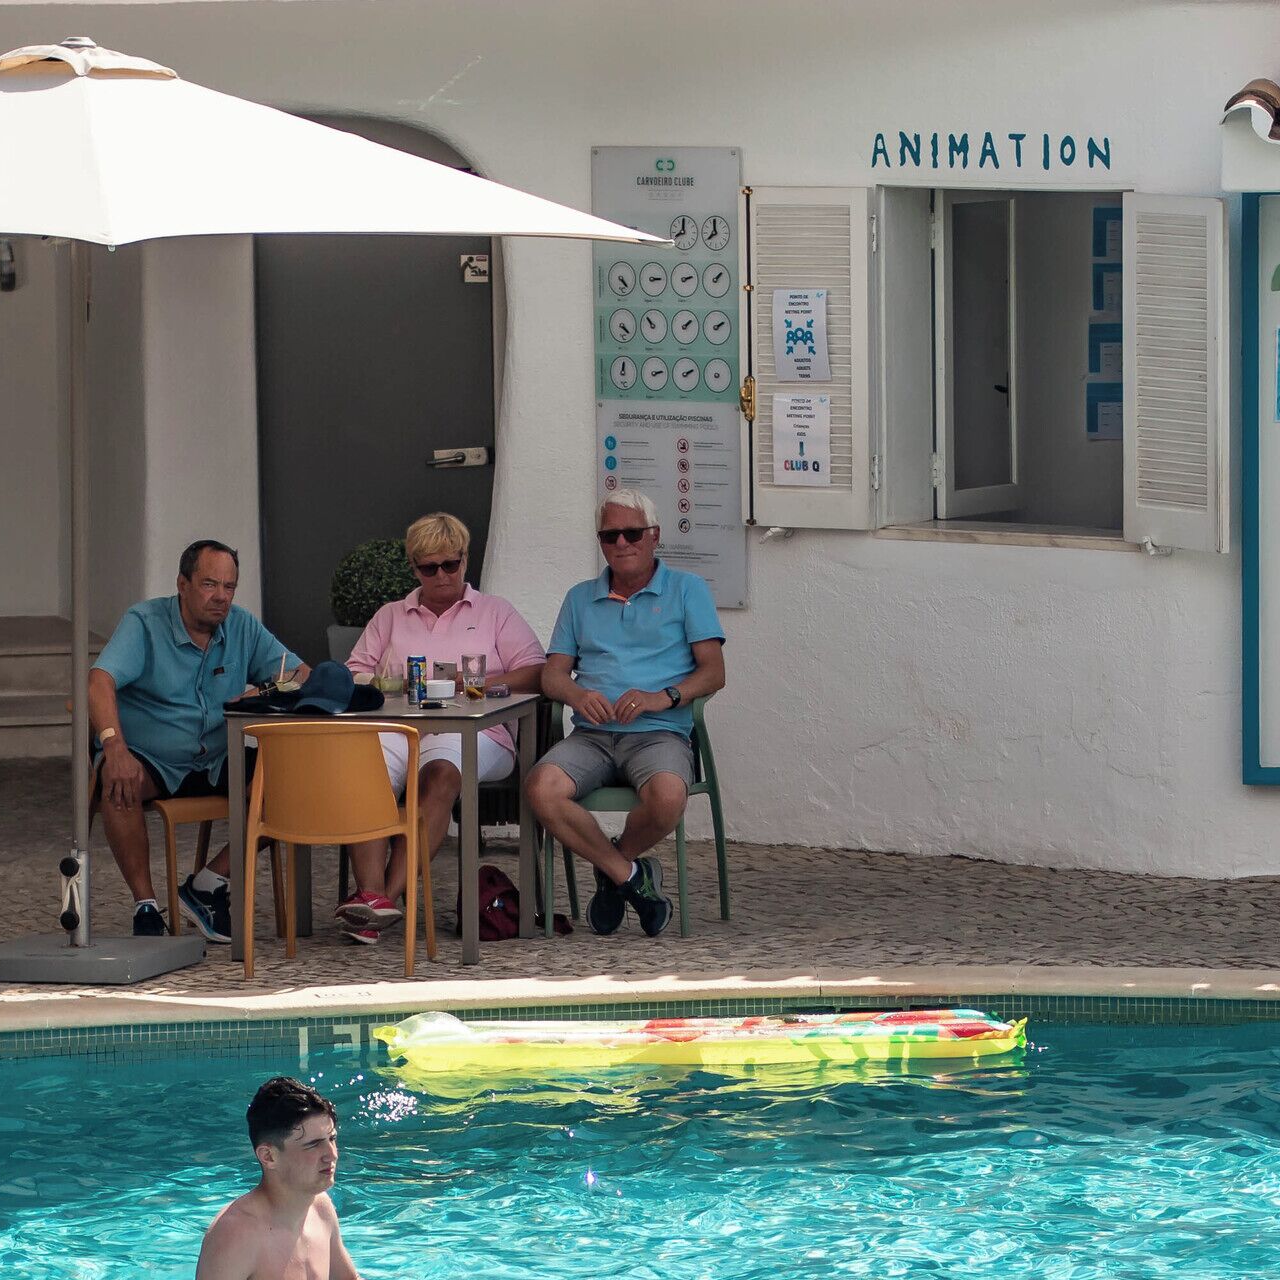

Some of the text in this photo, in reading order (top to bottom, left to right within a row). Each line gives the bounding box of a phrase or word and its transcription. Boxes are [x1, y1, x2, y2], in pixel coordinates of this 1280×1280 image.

[871, 130, 1111, 170] ANIMATION
[636, 176, 695, 187] CARVOEIRO CLUBE
[619, 413, 652, 421] SEGURANÇA
[656, 414, 687, 422] UTILIZAÇÃO
[784, 460, 820, 472] CLUB Q
